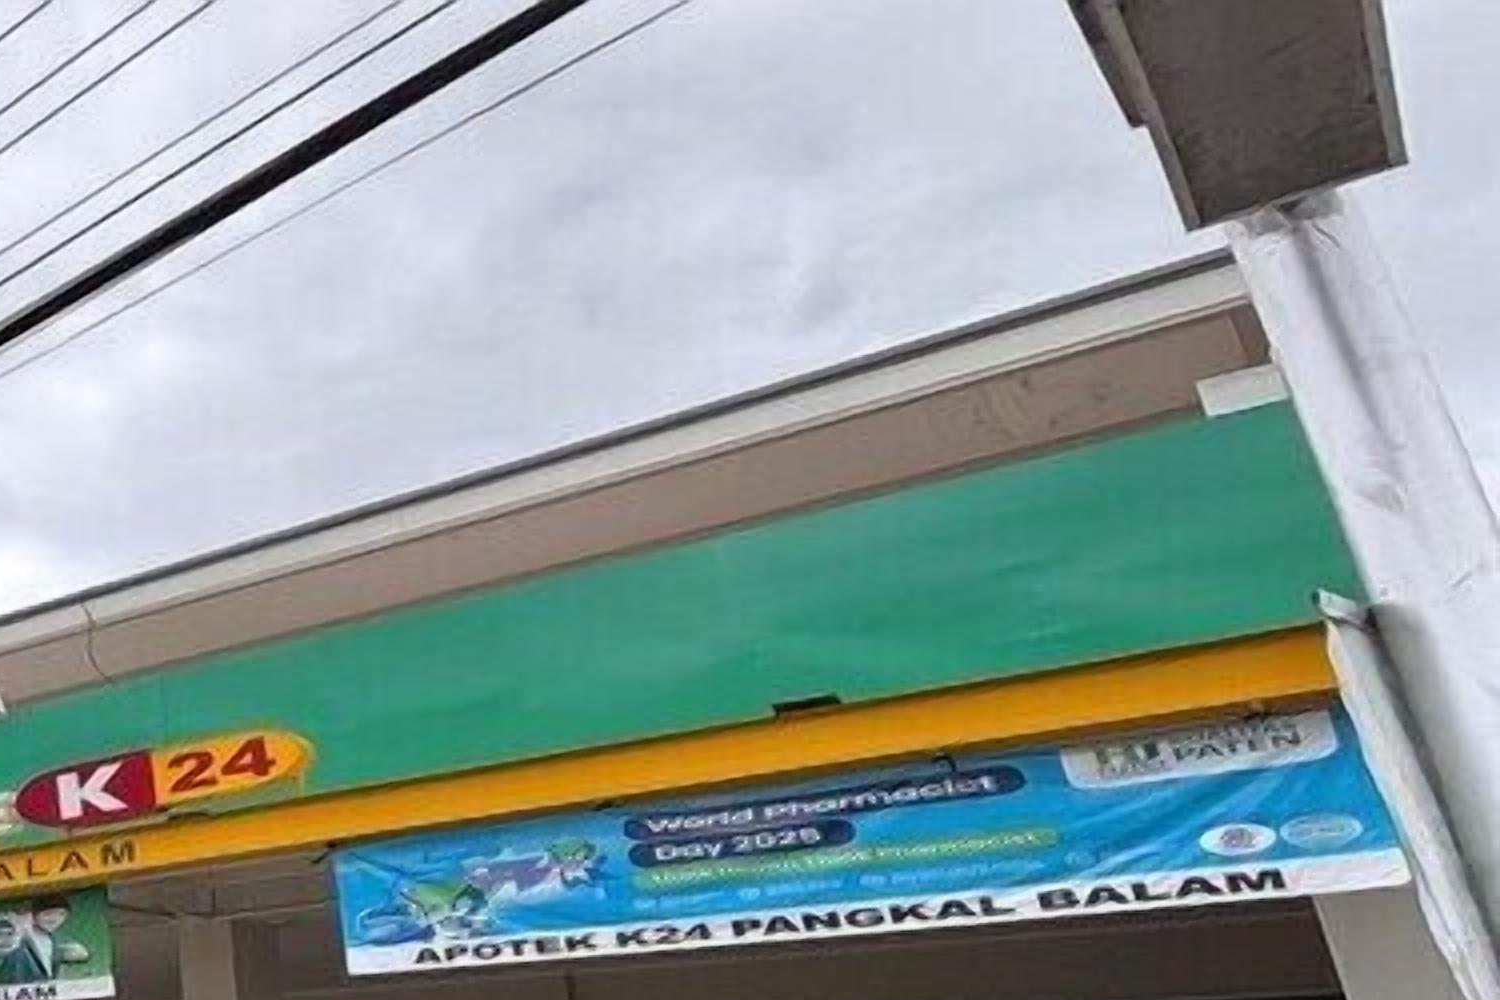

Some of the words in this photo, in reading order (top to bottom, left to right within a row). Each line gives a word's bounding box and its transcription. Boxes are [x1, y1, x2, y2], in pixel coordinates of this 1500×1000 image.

[648, 807, 753, 834] World
[764, 775, 995, 818] Pharmacist
[655, 840, 723, 862] Day
[414, 932, 598, 964] APOTEK
[616, 922, 712, 948] K24
[731, 894, 1016, 937] PANGKAL
[1037, 868, 1288, 910] BALAM
